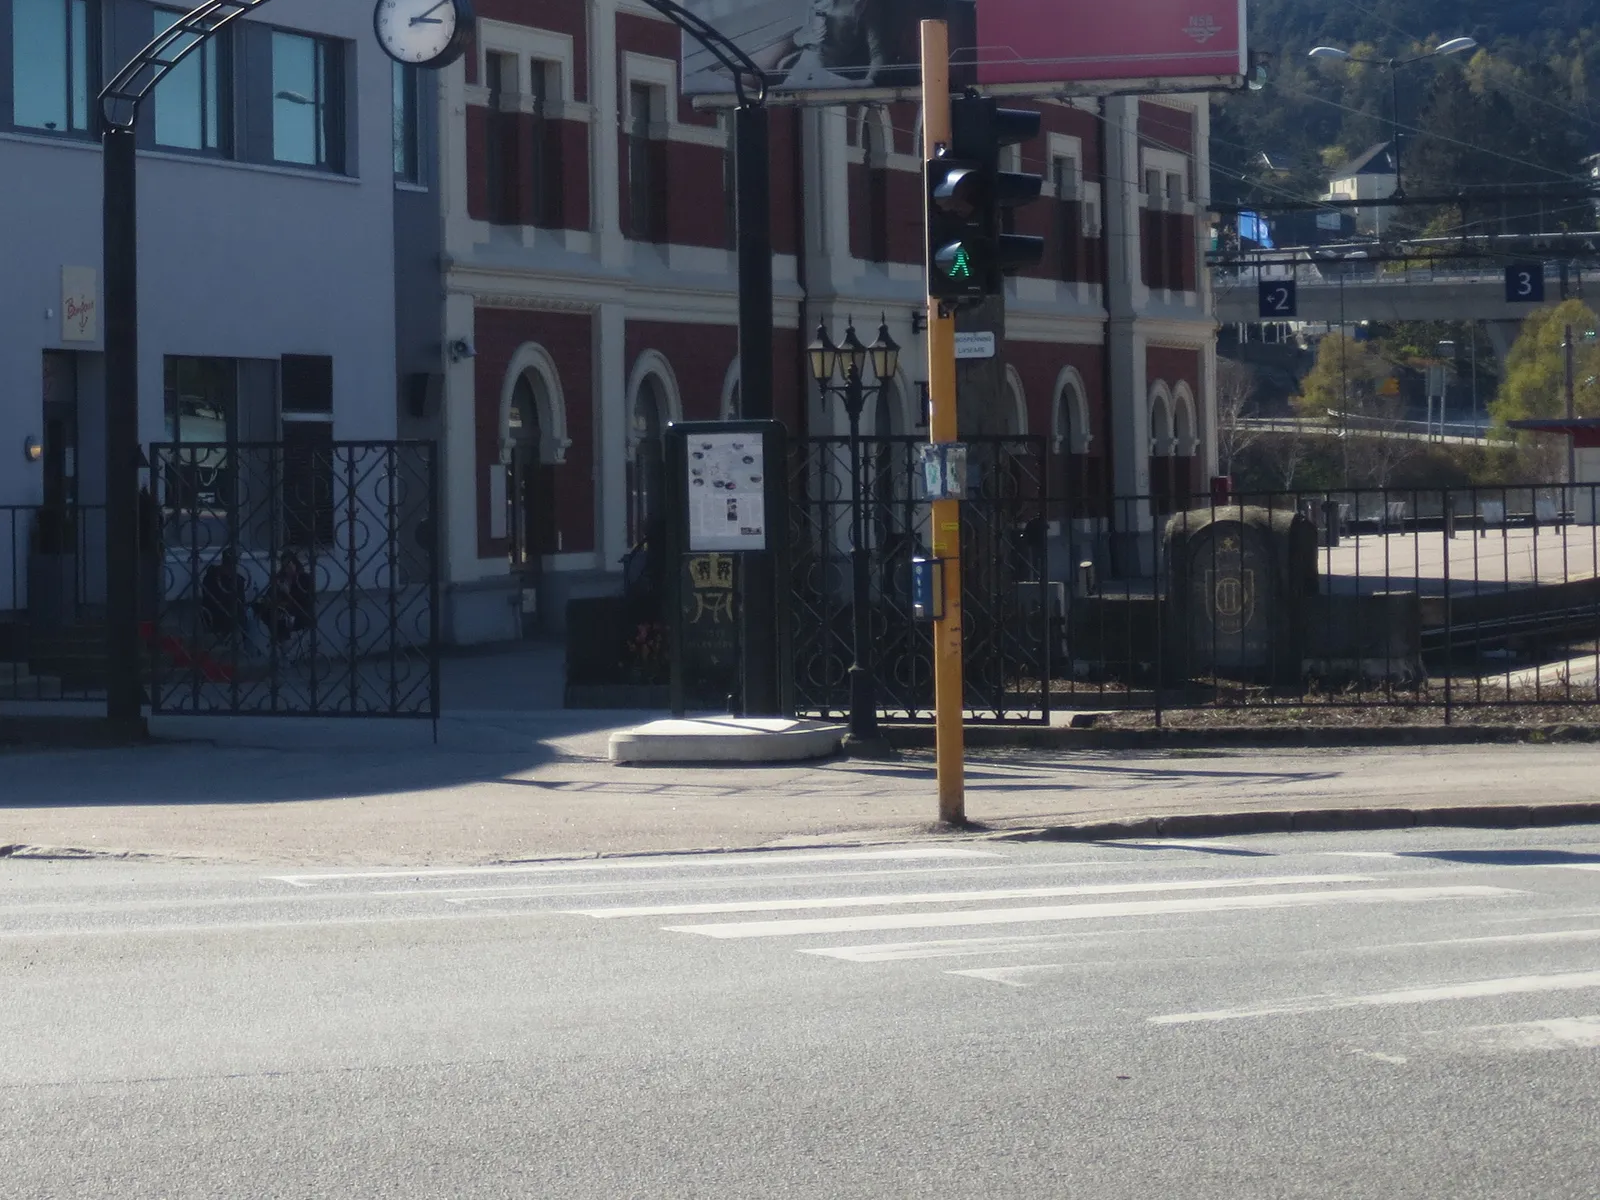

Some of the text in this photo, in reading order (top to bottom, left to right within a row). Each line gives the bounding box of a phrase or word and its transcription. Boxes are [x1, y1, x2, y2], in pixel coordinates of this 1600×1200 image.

[1188, 14, 1213, 26] NSB
[1518, 272, 1532, 295] 3
[1275, 288, 1289, 310] 2
